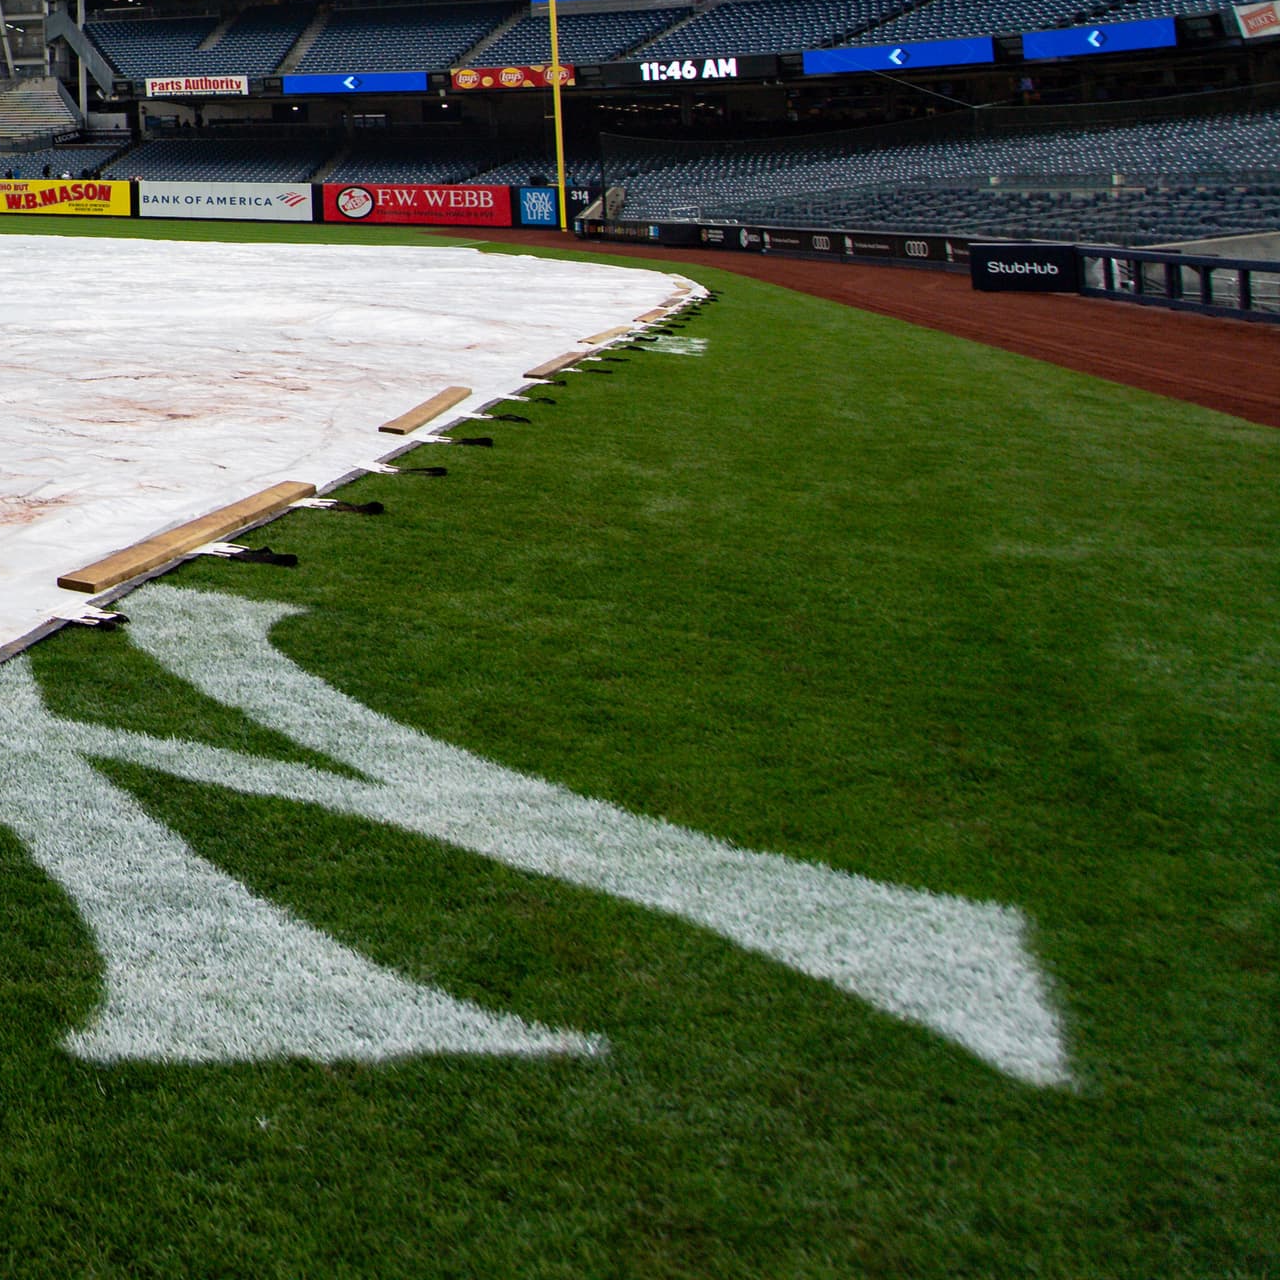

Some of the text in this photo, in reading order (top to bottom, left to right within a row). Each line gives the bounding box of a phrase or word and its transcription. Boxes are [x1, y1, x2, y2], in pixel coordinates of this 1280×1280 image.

[640, 58, 737, 81] 11:46 AM
[501, 73, 523, 82] Lay's
[151, 76, 242, 91] Parts Authority
[54, 131, 80, 144] LEGORA
[13, 183, 29, 192] BUT
[376, 189, 494, 208] F.W. WEBB
[526, 192, 550, 202] NEW
[571, 190, 589, 200] 314
[142, 195, 273, 207] BANK OF AMERICA
[523, 200, 553, 211] YORK
[527, 210, 550, 220] LIFE
[987, 261, 1059, 275] StubHub
